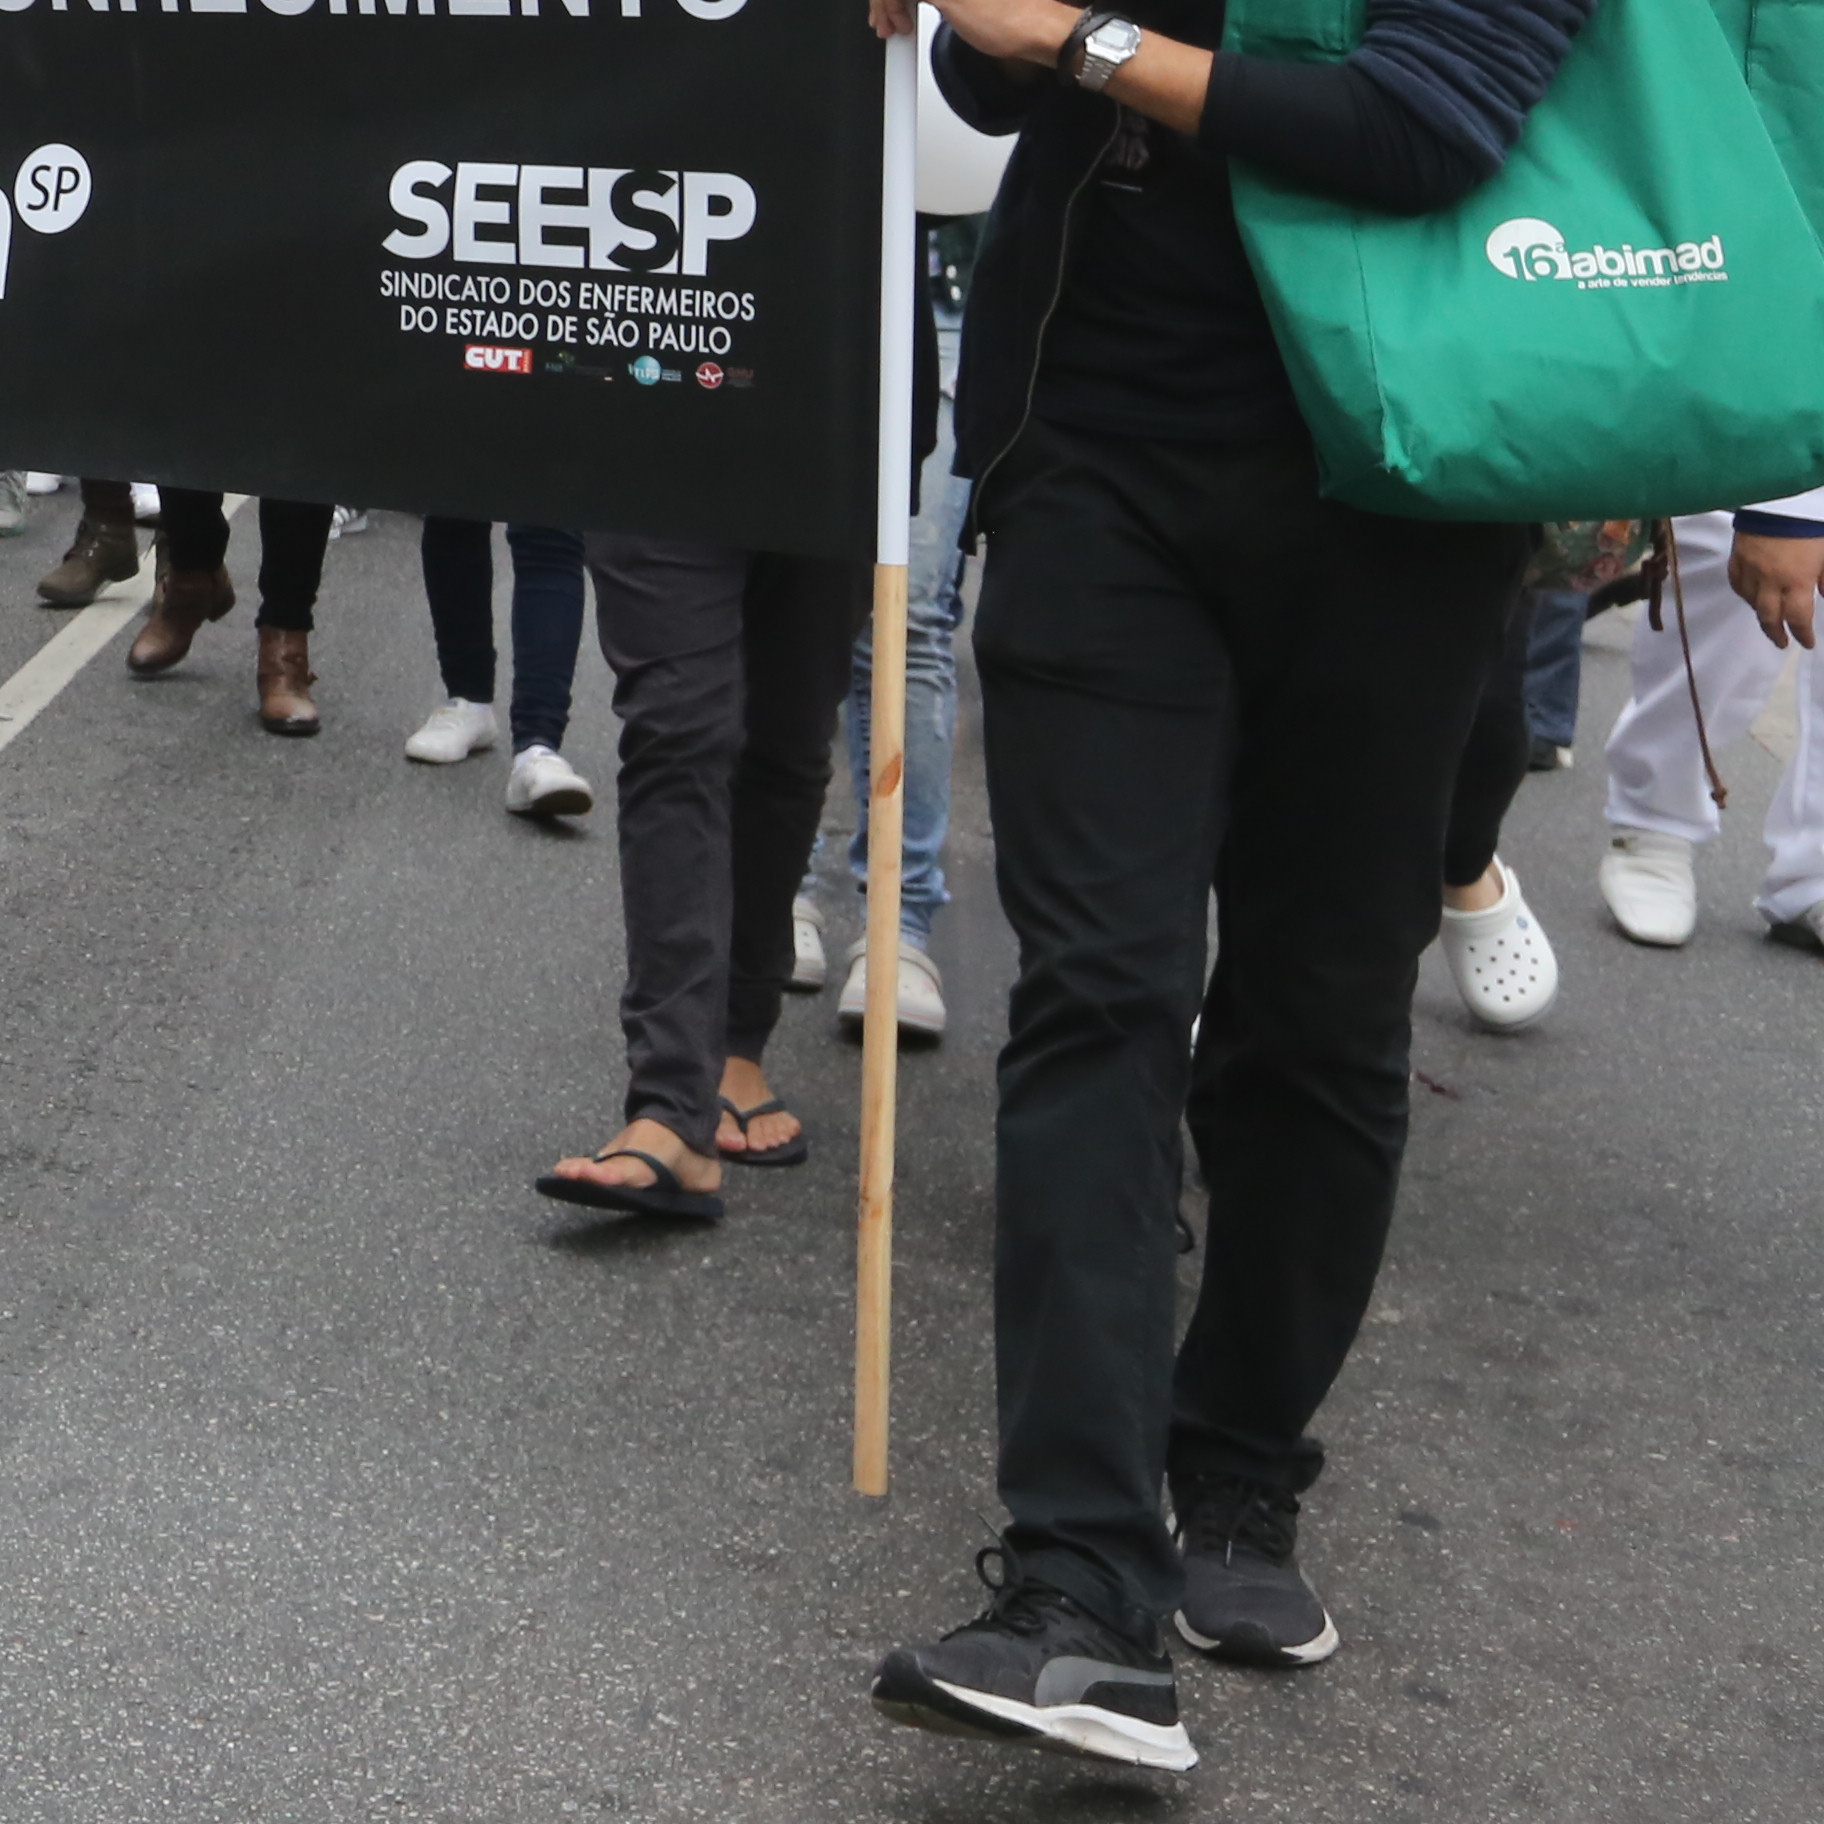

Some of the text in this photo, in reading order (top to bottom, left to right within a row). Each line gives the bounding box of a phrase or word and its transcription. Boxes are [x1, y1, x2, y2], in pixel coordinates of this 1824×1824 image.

[381, 159, 758, 276] SEESP
[1571, 234, 1726, 279] abimad
[380, 269, 756, 322] SINDICATO DOS ENFERMEIROS
[1577, 279, 1586, 289] a
[1588, 277, 1610, 288] arte
[1613, 277, 1629, 288] de
[1631, 276, 1672, 288] vender
[400, 305, 732, 355] DO ESTADO DE SÃO PAULO
[464, 346, 523, 371] CUT
